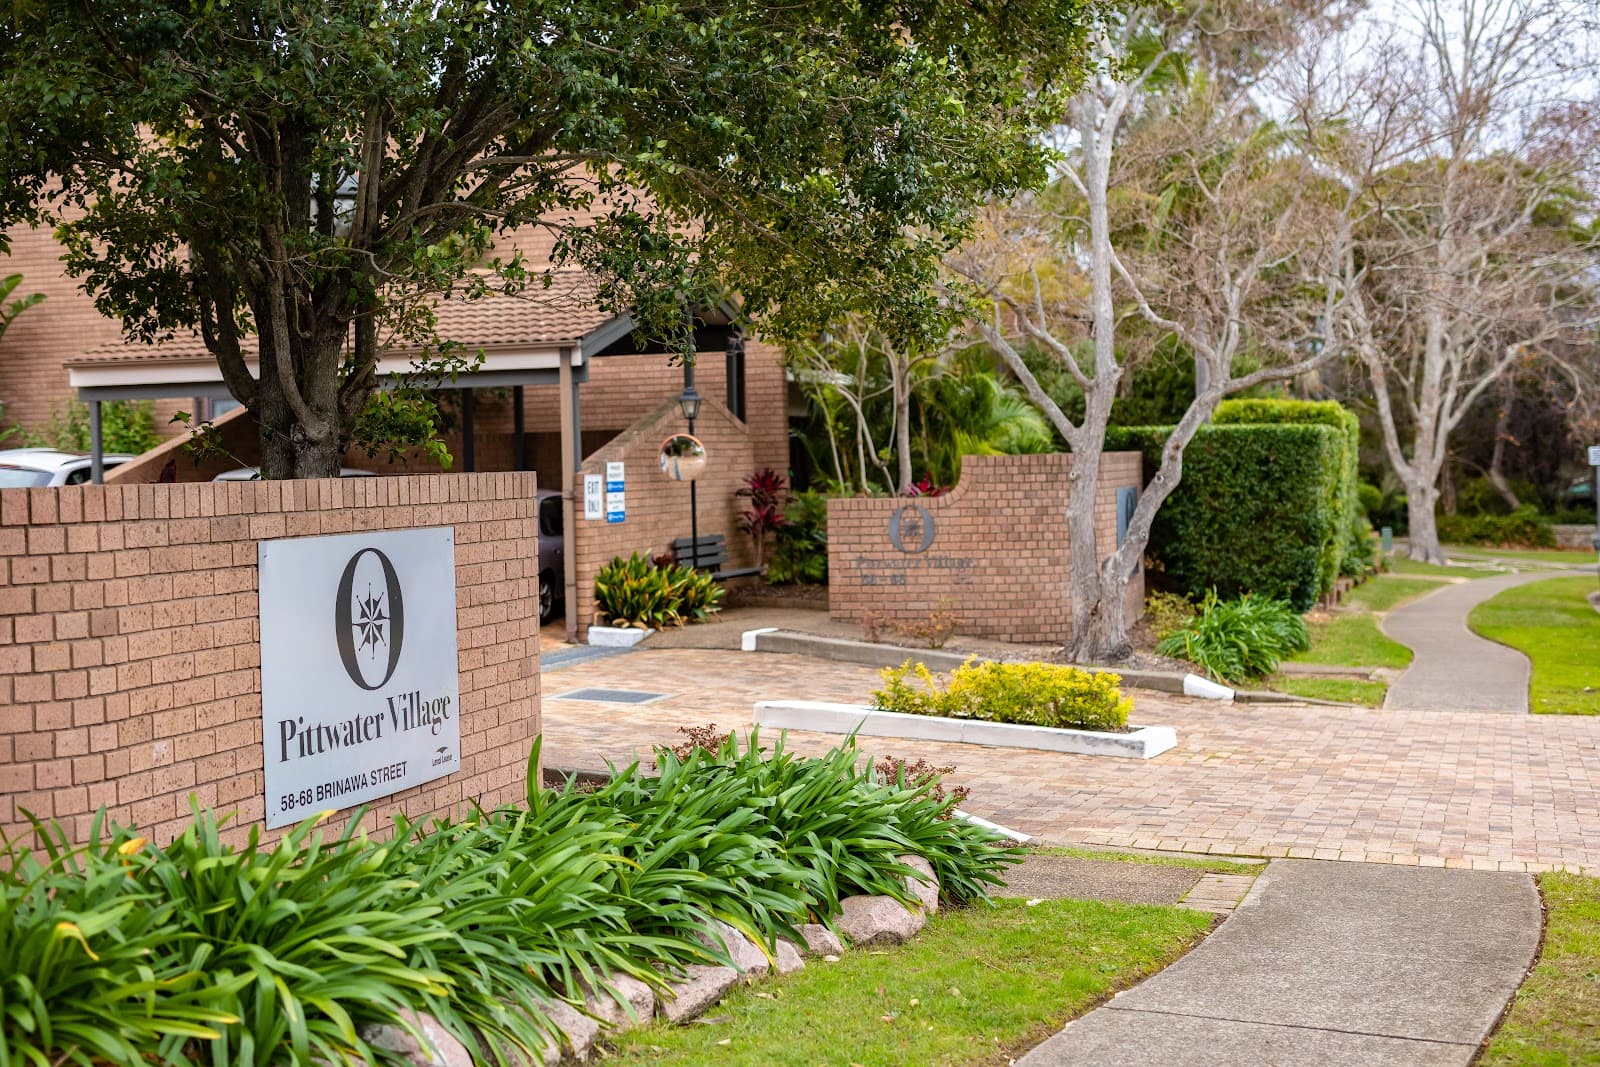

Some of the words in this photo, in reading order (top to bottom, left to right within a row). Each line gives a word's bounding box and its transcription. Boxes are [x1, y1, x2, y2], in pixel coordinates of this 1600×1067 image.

[277, 712, 385, 763] Pittwater
[386, 690, 451, 736] Village
[281, 788, 313, 812] 58-68
[316, 773, 369, 802] BRINAWA
[370, 761, 408, 786] STREET
